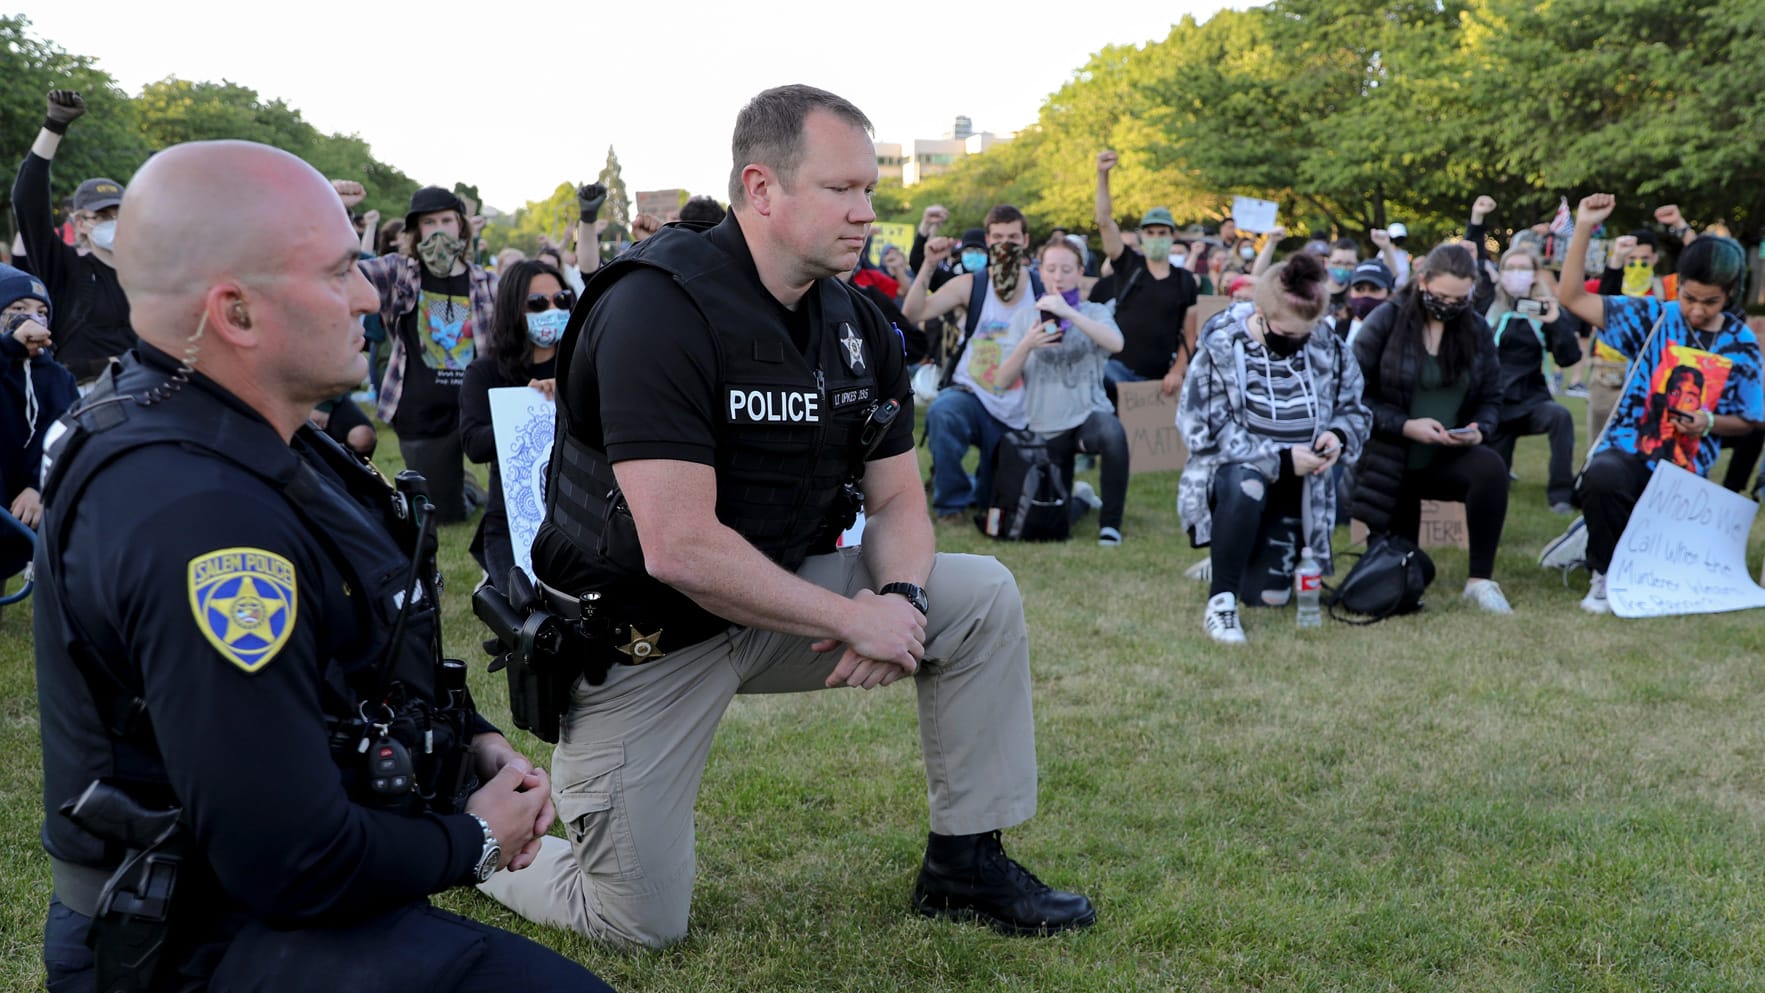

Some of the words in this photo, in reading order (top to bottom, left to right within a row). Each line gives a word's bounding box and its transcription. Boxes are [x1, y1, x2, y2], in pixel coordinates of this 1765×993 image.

[730, 389, 819, 422] POLICE
[1627, 518, 1663, 557] Call
[195, 553, 243, 585] SALEM
[245, 553, 293, 585] POLICE
